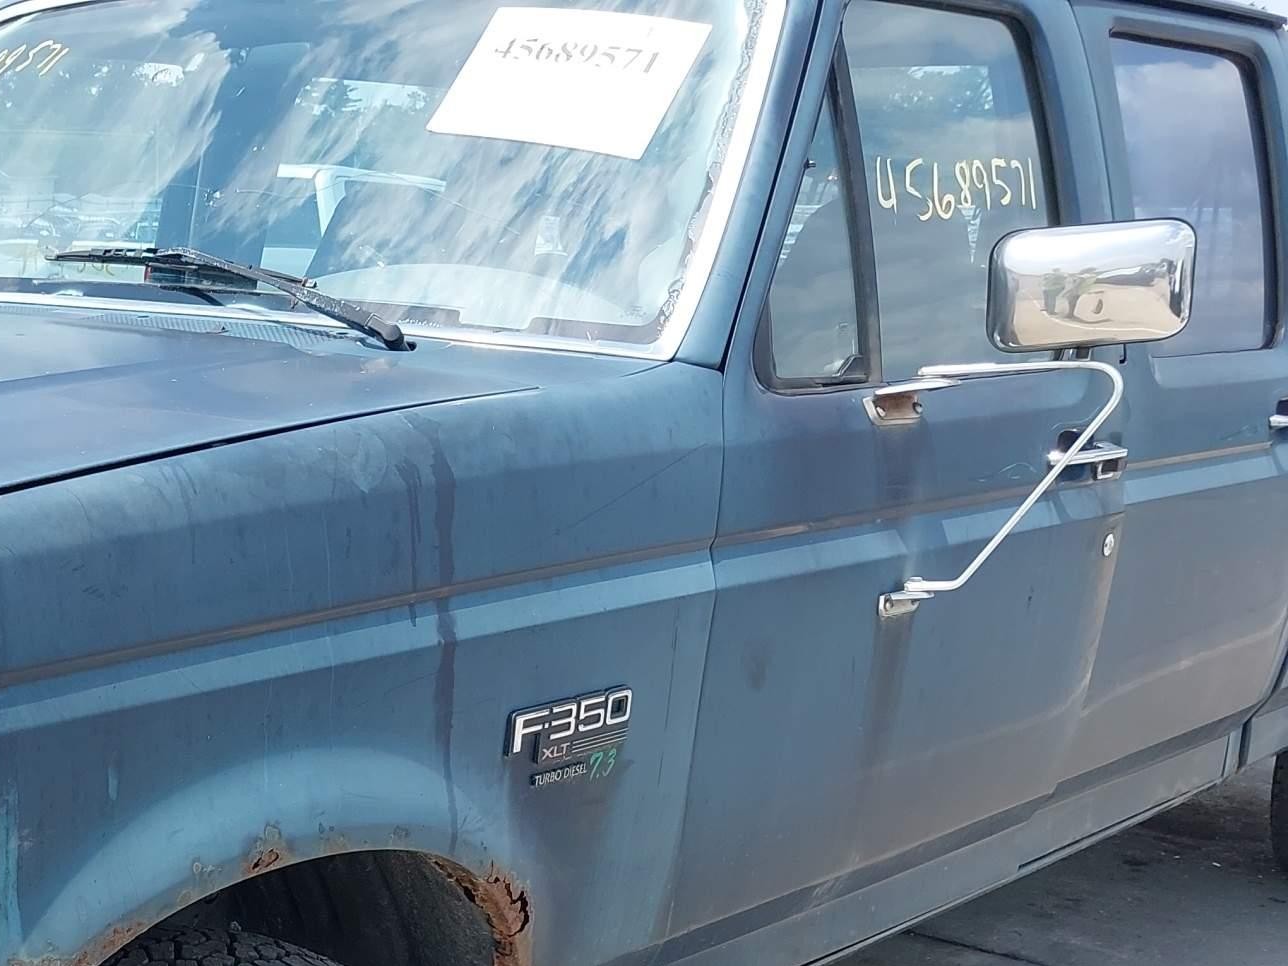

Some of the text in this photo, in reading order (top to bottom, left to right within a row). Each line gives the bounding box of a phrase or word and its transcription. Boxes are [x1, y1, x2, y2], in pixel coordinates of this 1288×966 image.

[494, 37, 661, 75] 45689571
[541, 742, 571, 761] XLT
[534, 761, 588, 788] TURBO DIESEL
